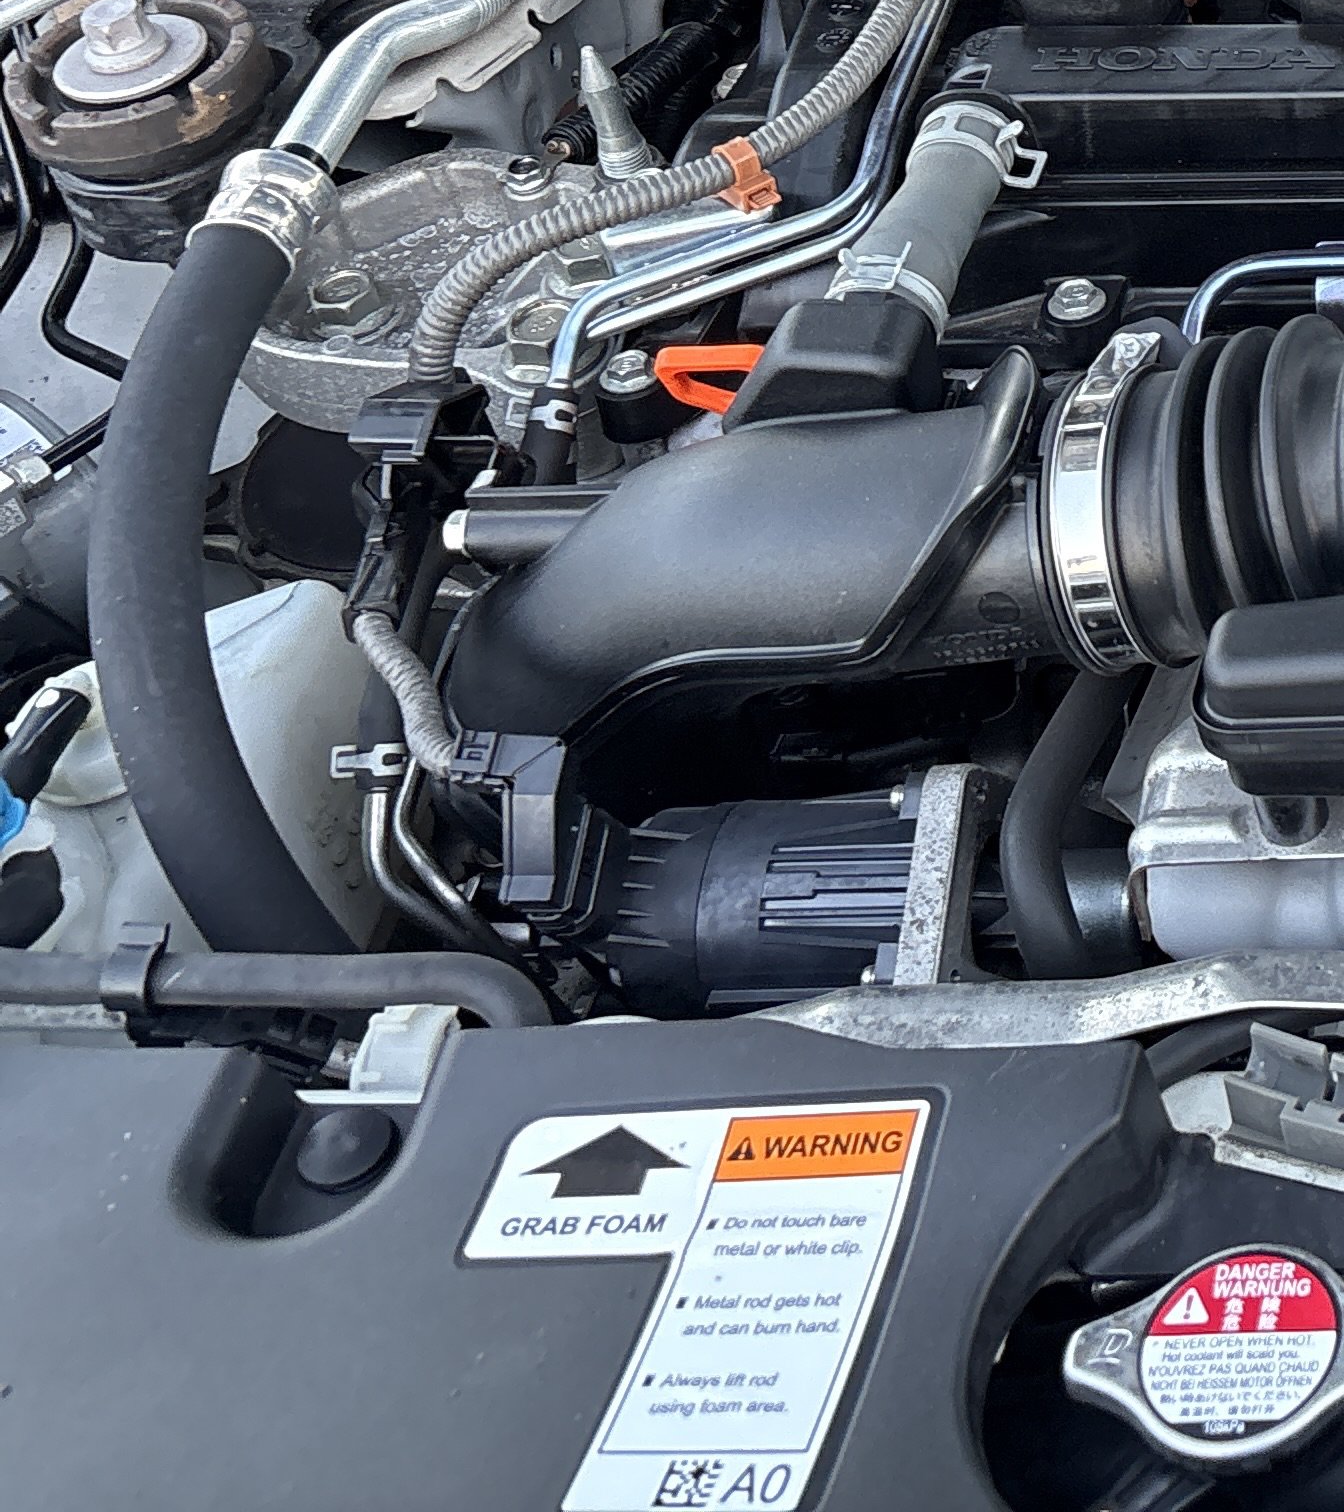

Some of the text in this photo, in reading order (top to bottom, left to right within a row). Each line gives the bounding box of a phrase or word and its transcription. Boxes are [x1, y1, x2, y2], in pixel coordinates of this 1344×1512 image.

[1031, 45, 1342, 72] HONDA
[763, 1130, 904, 1160] WARNING
[500, 1213, 669, 1238] GRAB FOAM
[723, 1213, 867, 1230] Do not touch bare
[713, 1240, 863, 1258] metal or white clip.
[1215, 1262, 1296, 1280] DANGER
[1213, 1278, 1311, 1299] WARNUNG
[694, 1292, 843, 1312] Metal rod gets hot
[682, 1318, 840, 1337] and can burn hand.
[1164, 1338, 1206, 1350] NEVER
[1209, 1337, 1244, 1349] OPEN
[1248, 1335, 1284, 1347] WHEN
[1162, 1351, 1181, 1362] Hot
[1184, 1350, 1223, 1361] coolant
[1227, 1350, 1243, 1360] will
[1246, 1349, 1275, 1360] scald
[1208, 1363, 1232, 1374] PAS
[1234, 1362, 1276, 1374] QUAND
[1279, 1360, 1320, 1373] CHAUD
[660, 1372, 780, 1391] Always lift rod
[1239, 1376, 1273, 1388] MOTOR
[649, 1399, 790, 1417] using foam area.
[719, 1463, 792, 1504] A0
